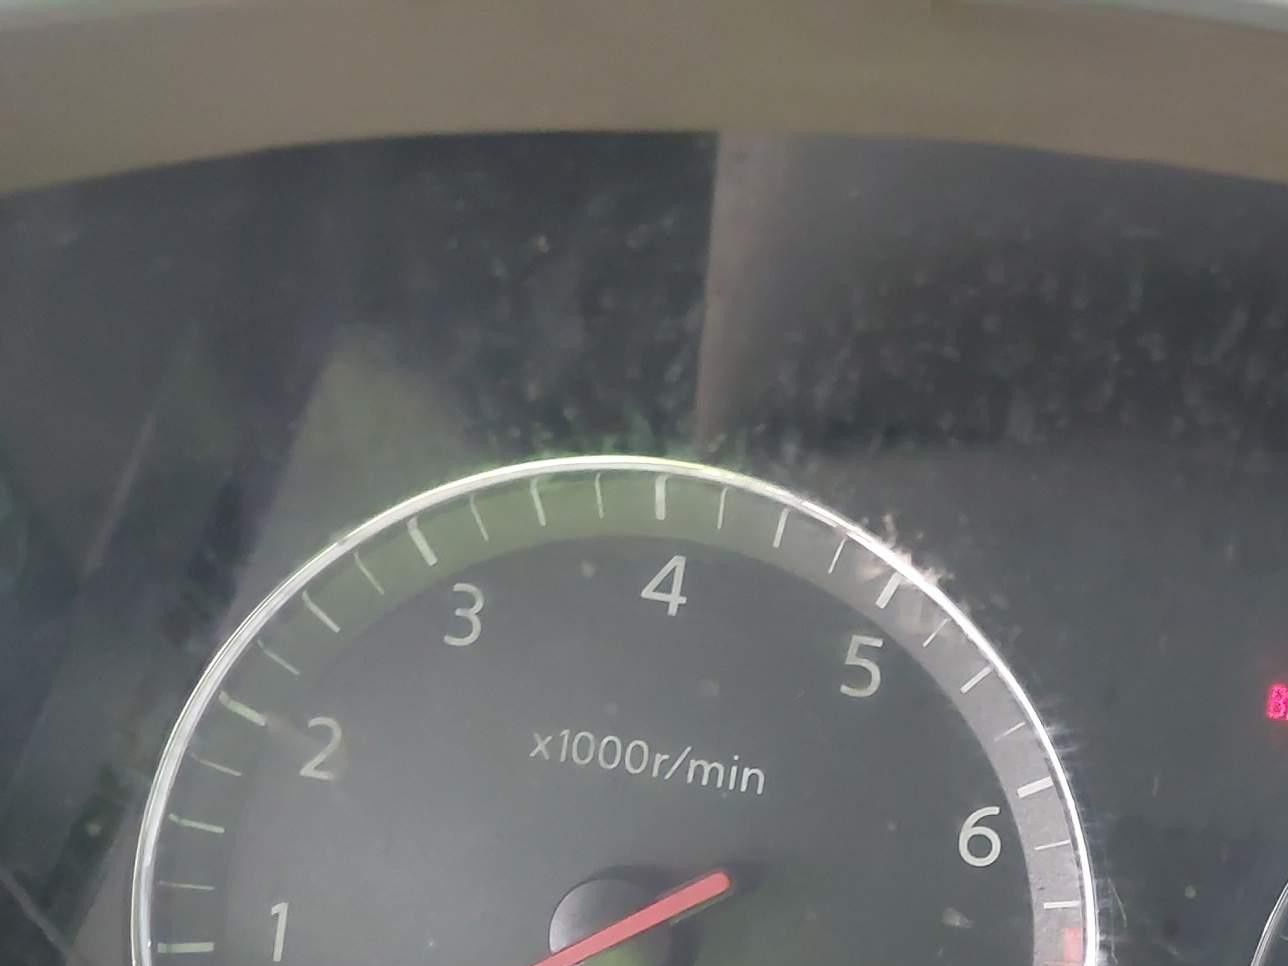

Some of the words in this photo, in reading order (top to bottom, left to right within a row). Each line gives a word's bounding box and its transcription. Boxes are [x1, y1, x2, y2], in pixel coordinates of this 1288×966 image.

[443, 582, 485, 647] 3
[640, 555, 688, 617] 4
[839, 634, 884, 698] 5
[299, 716, 343, 781] 2
[528, 728, 767, 796] x1000r/min
[957, 806, 1002, 867] 6
[270, 901, 289, 962] 1
